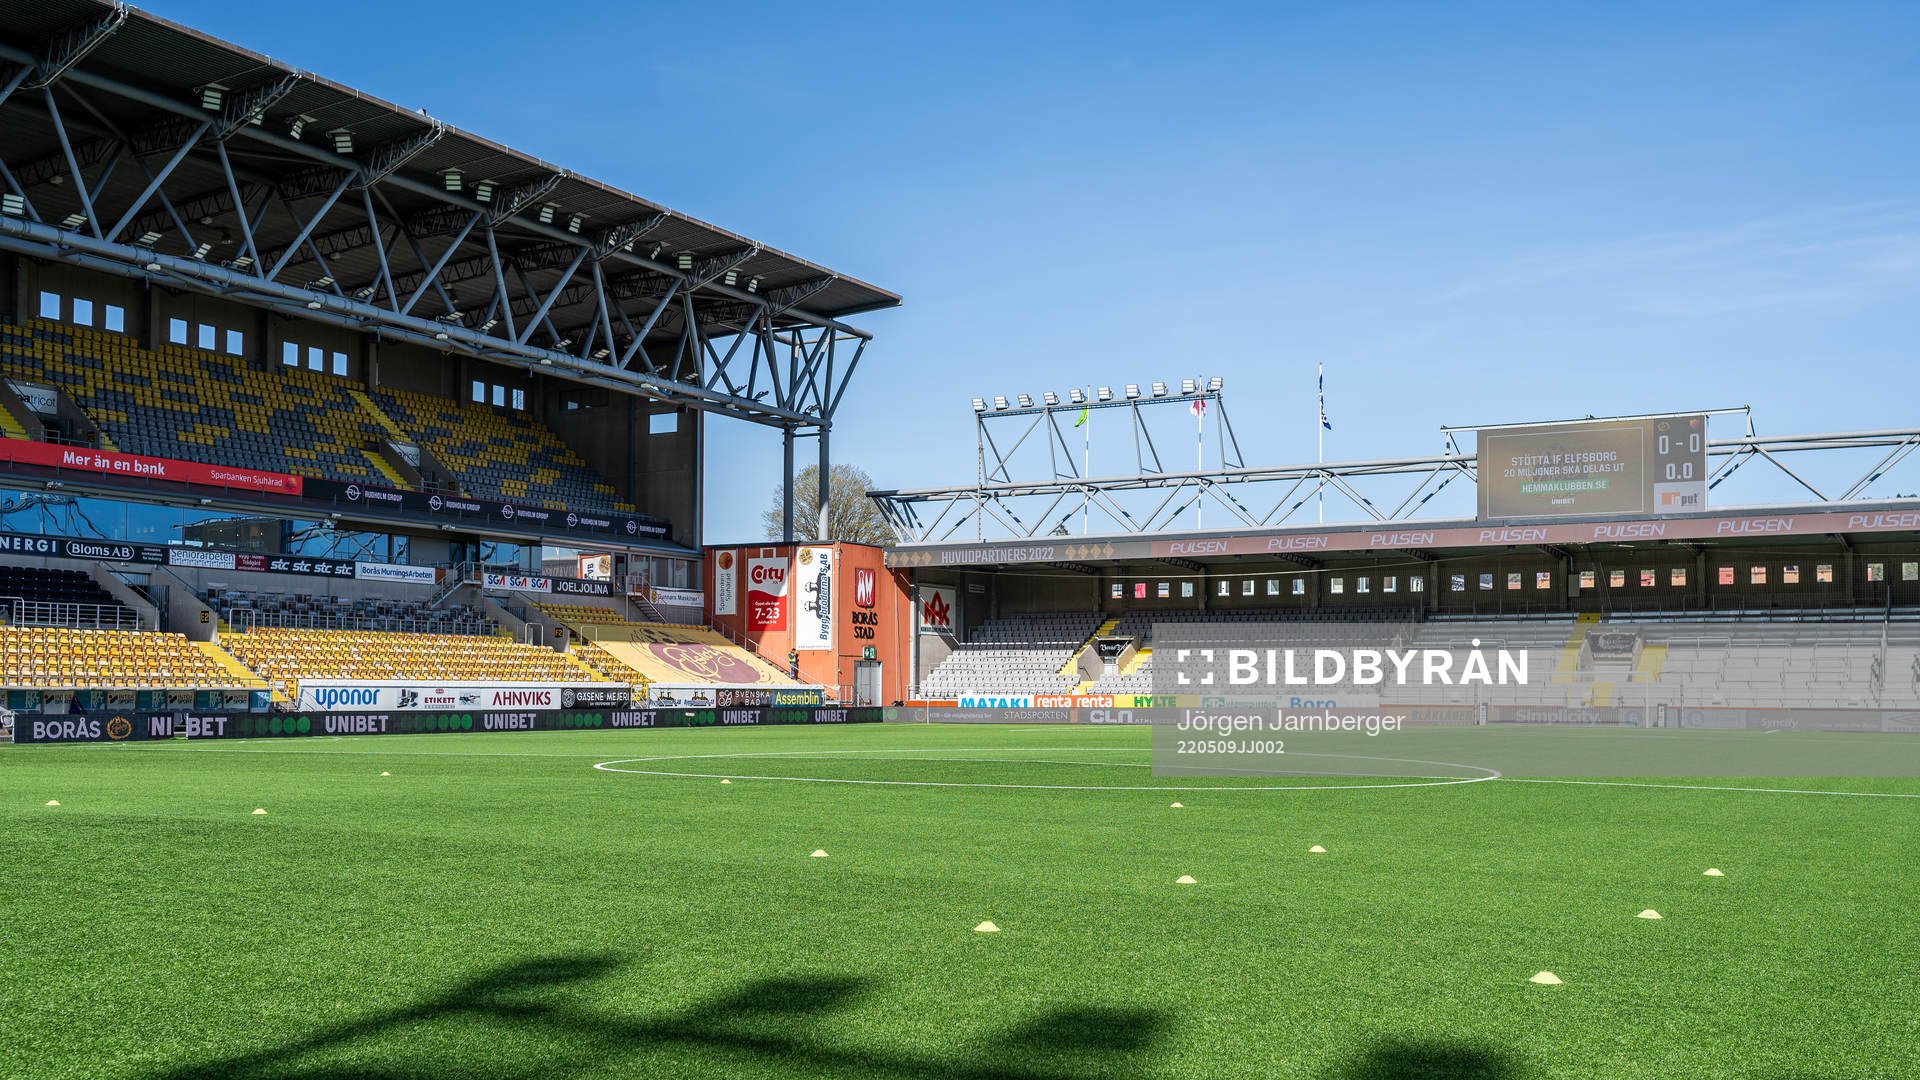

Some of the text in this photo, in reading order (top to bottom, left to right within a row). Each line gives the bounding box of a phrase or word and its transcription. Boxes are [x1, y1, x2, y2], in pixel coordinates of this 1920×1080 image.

[1658, 435, 1669, 455] 0
[1689, 433, 1700, 453] 0
[63, 450, 165, 475] Mer än en bank
[1511, 451, 1617, 466] STÖTTA IF ELFSBORG
[1504, 463, 1625, 478] 20 MILJONER SKA DELAS UT
[1665, 462, 1693, 480] 0.0
[210, 470, 283, 487] Sparbanken Sjuhärad
[1522, 480, 1607, 493] HEMMAKLUBBEN.SE
[388, 493, 403, 502] GROUP
[1671, 491, 1699, 507] input
[467, 503, 481, 512] GROUP
[536, 512, 549, 520] GROUP
[1848, 513, 1920, 529] PULSEN
[1593, 523, 1666, 538] PULSEN
[1716, 518, 1793, 534] PULSEN
[1267, 536, 1328, 550] PULSEN
[1370, 532, 1435, 546] PULSEN
[1479, 529, 1547, 543] PULSEN
[71, 543, 109, 556] Bloms
[112, 547, 130, 557] AB
[1169, 541, 1227, 554] PULSEN
[941, 547, 1054, 564] HUVUDPARTNERS 2022
[270, 558, 290, 571] stc
[292, 560, 312, 572] stc
[314, 562, 333, 574] stc
[335, 563, 353, 576] stc
[362, 566, 380, 576] Borås
[751, 565, 785, 585] City
[556, 580, 609, 595] JOELJOLINA
[755, 608, 780, 620] 7-23
[924, 590, 950, 626] MAX
[852, 609, 878, 626] BORÅS
[854, 626, 875, 640] STAD
[315, 688, 381, 709] uponor
[492, 691, 551, 706] AHNVIKS
[576, 691, 630, 701] GÄSENE MEJERI
[735, 690, 771, 698] SVENSKA
[775, 691, 820, 706] Assemblin
[961, 697, 1028, 708] MATAKI
[1037, 695, 1072, 708] renta
[1076, 695, 1113, 708] renta
[1134, 696, 1177, 708] HYLTE
[484, 713, 537, 729] UNIBET
[611, 711, 656, 727] UNIBET
[723, 710, 760, 724] UNIBET
[814, 709, 848, 723] UNIBET
[1003, 711, 1069, 720] STADSPORTEN
[1658, 704, 1666, 727] SELECT
[1761, 717, 1799, 728] Syncify
[33, 716, 101, 739] BORÅS
[188, 716, 228, 737] BET
[325, 715, 389, 733] UNIBET
[1850, 721, 1861, 729] the
